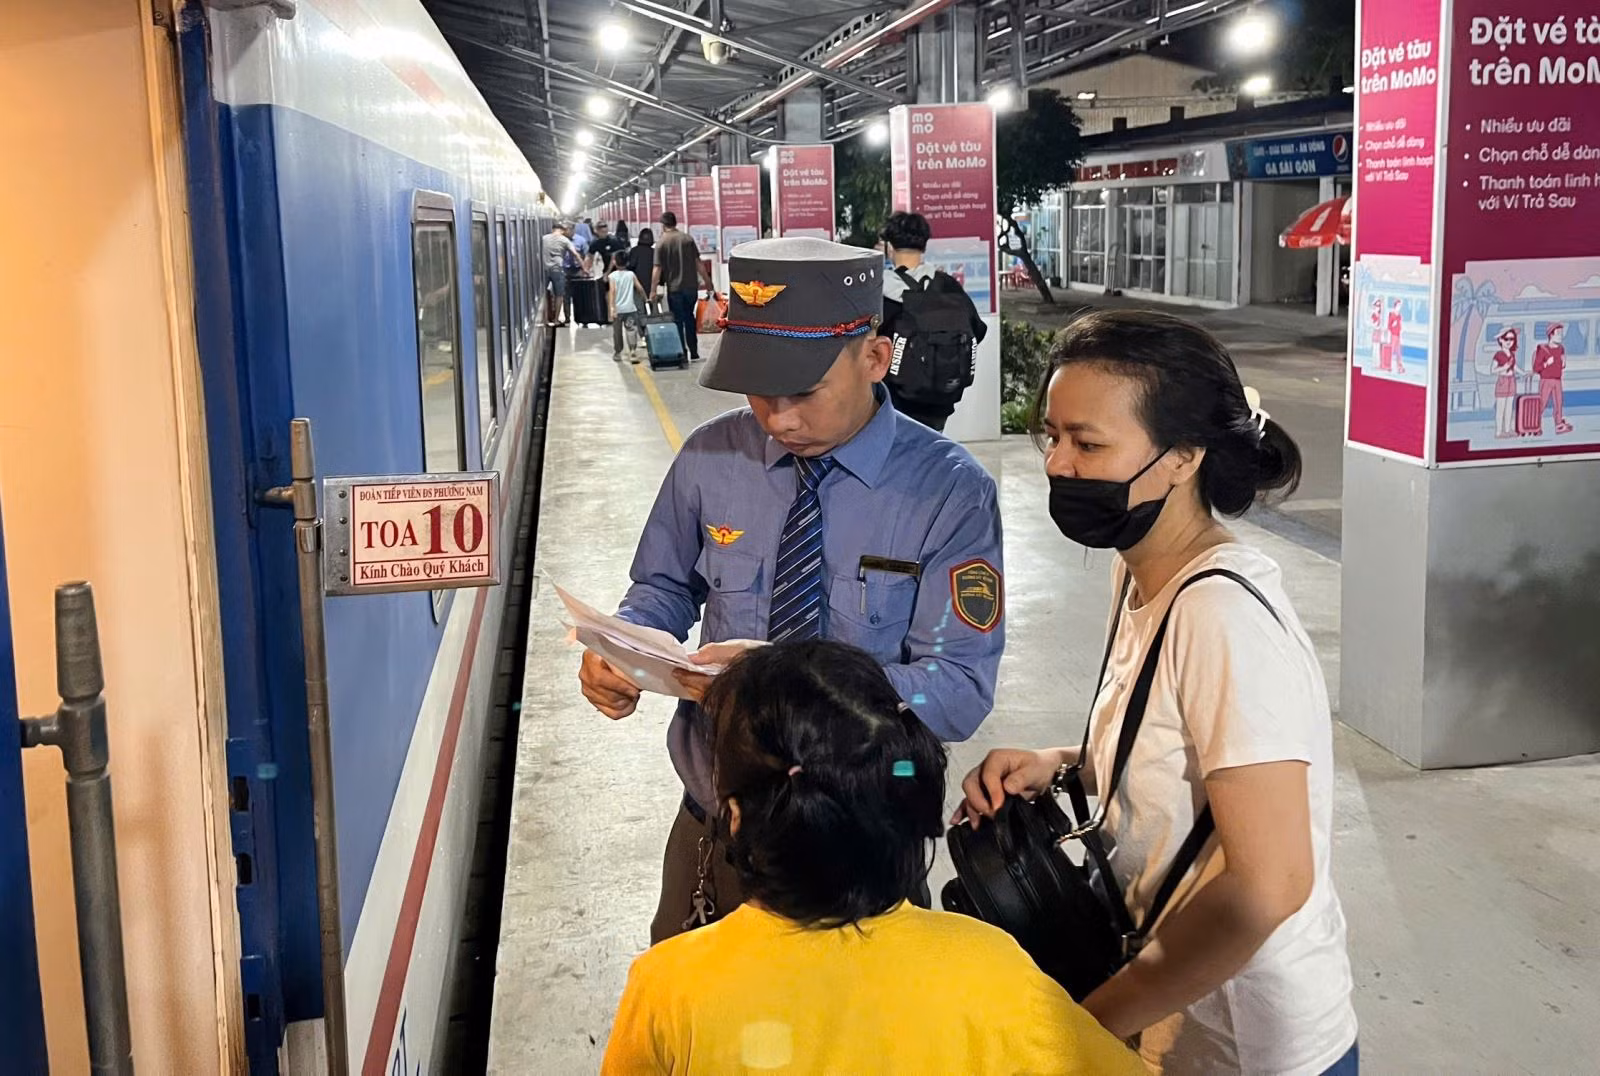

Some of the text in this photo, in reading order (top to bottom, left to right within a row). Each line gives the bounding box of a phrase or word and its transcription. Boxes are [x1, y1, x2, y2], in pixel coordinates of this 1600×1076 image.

[1469, 15, 1600, 52] Đặt vé tà
[1361, 46, 1387, 71] Đặt
[1387, 41, 1405, 64] vé
[1360, 65, 1437, 95] trên MoMo
[1468, 56, 1531, 85] trên
[1480, 116, 1571, 134] Nhiều ưu đãi
[916, 140, 982, 157] Đặt vé tàu
[1479, 142, 1600, 165] Chọn chỗ dễ dàn
[916, 156, 987, 171] trên MoMo
[1479, 175, 1525, 191] Thanh
[1529, 173, 1561, 189] toán
[1564, 173, 1591, 188] linh
[1478, 192, 1576, 210] với Ví Trả Sau
[889, 336, 908, 376] INSIDER
[360, 488, 382, 501] ĐOÀN
[383, 485, 402, 500] TIẾP
[403, 486, 421, 499] VIÊN
[422, 486, 433, 498] ĐS
[466, 485, 483, 497] NAM
[360, 503, 484, 556] TOA 10
[360, 558, 484, 580] Kính Chào Quý Khách
